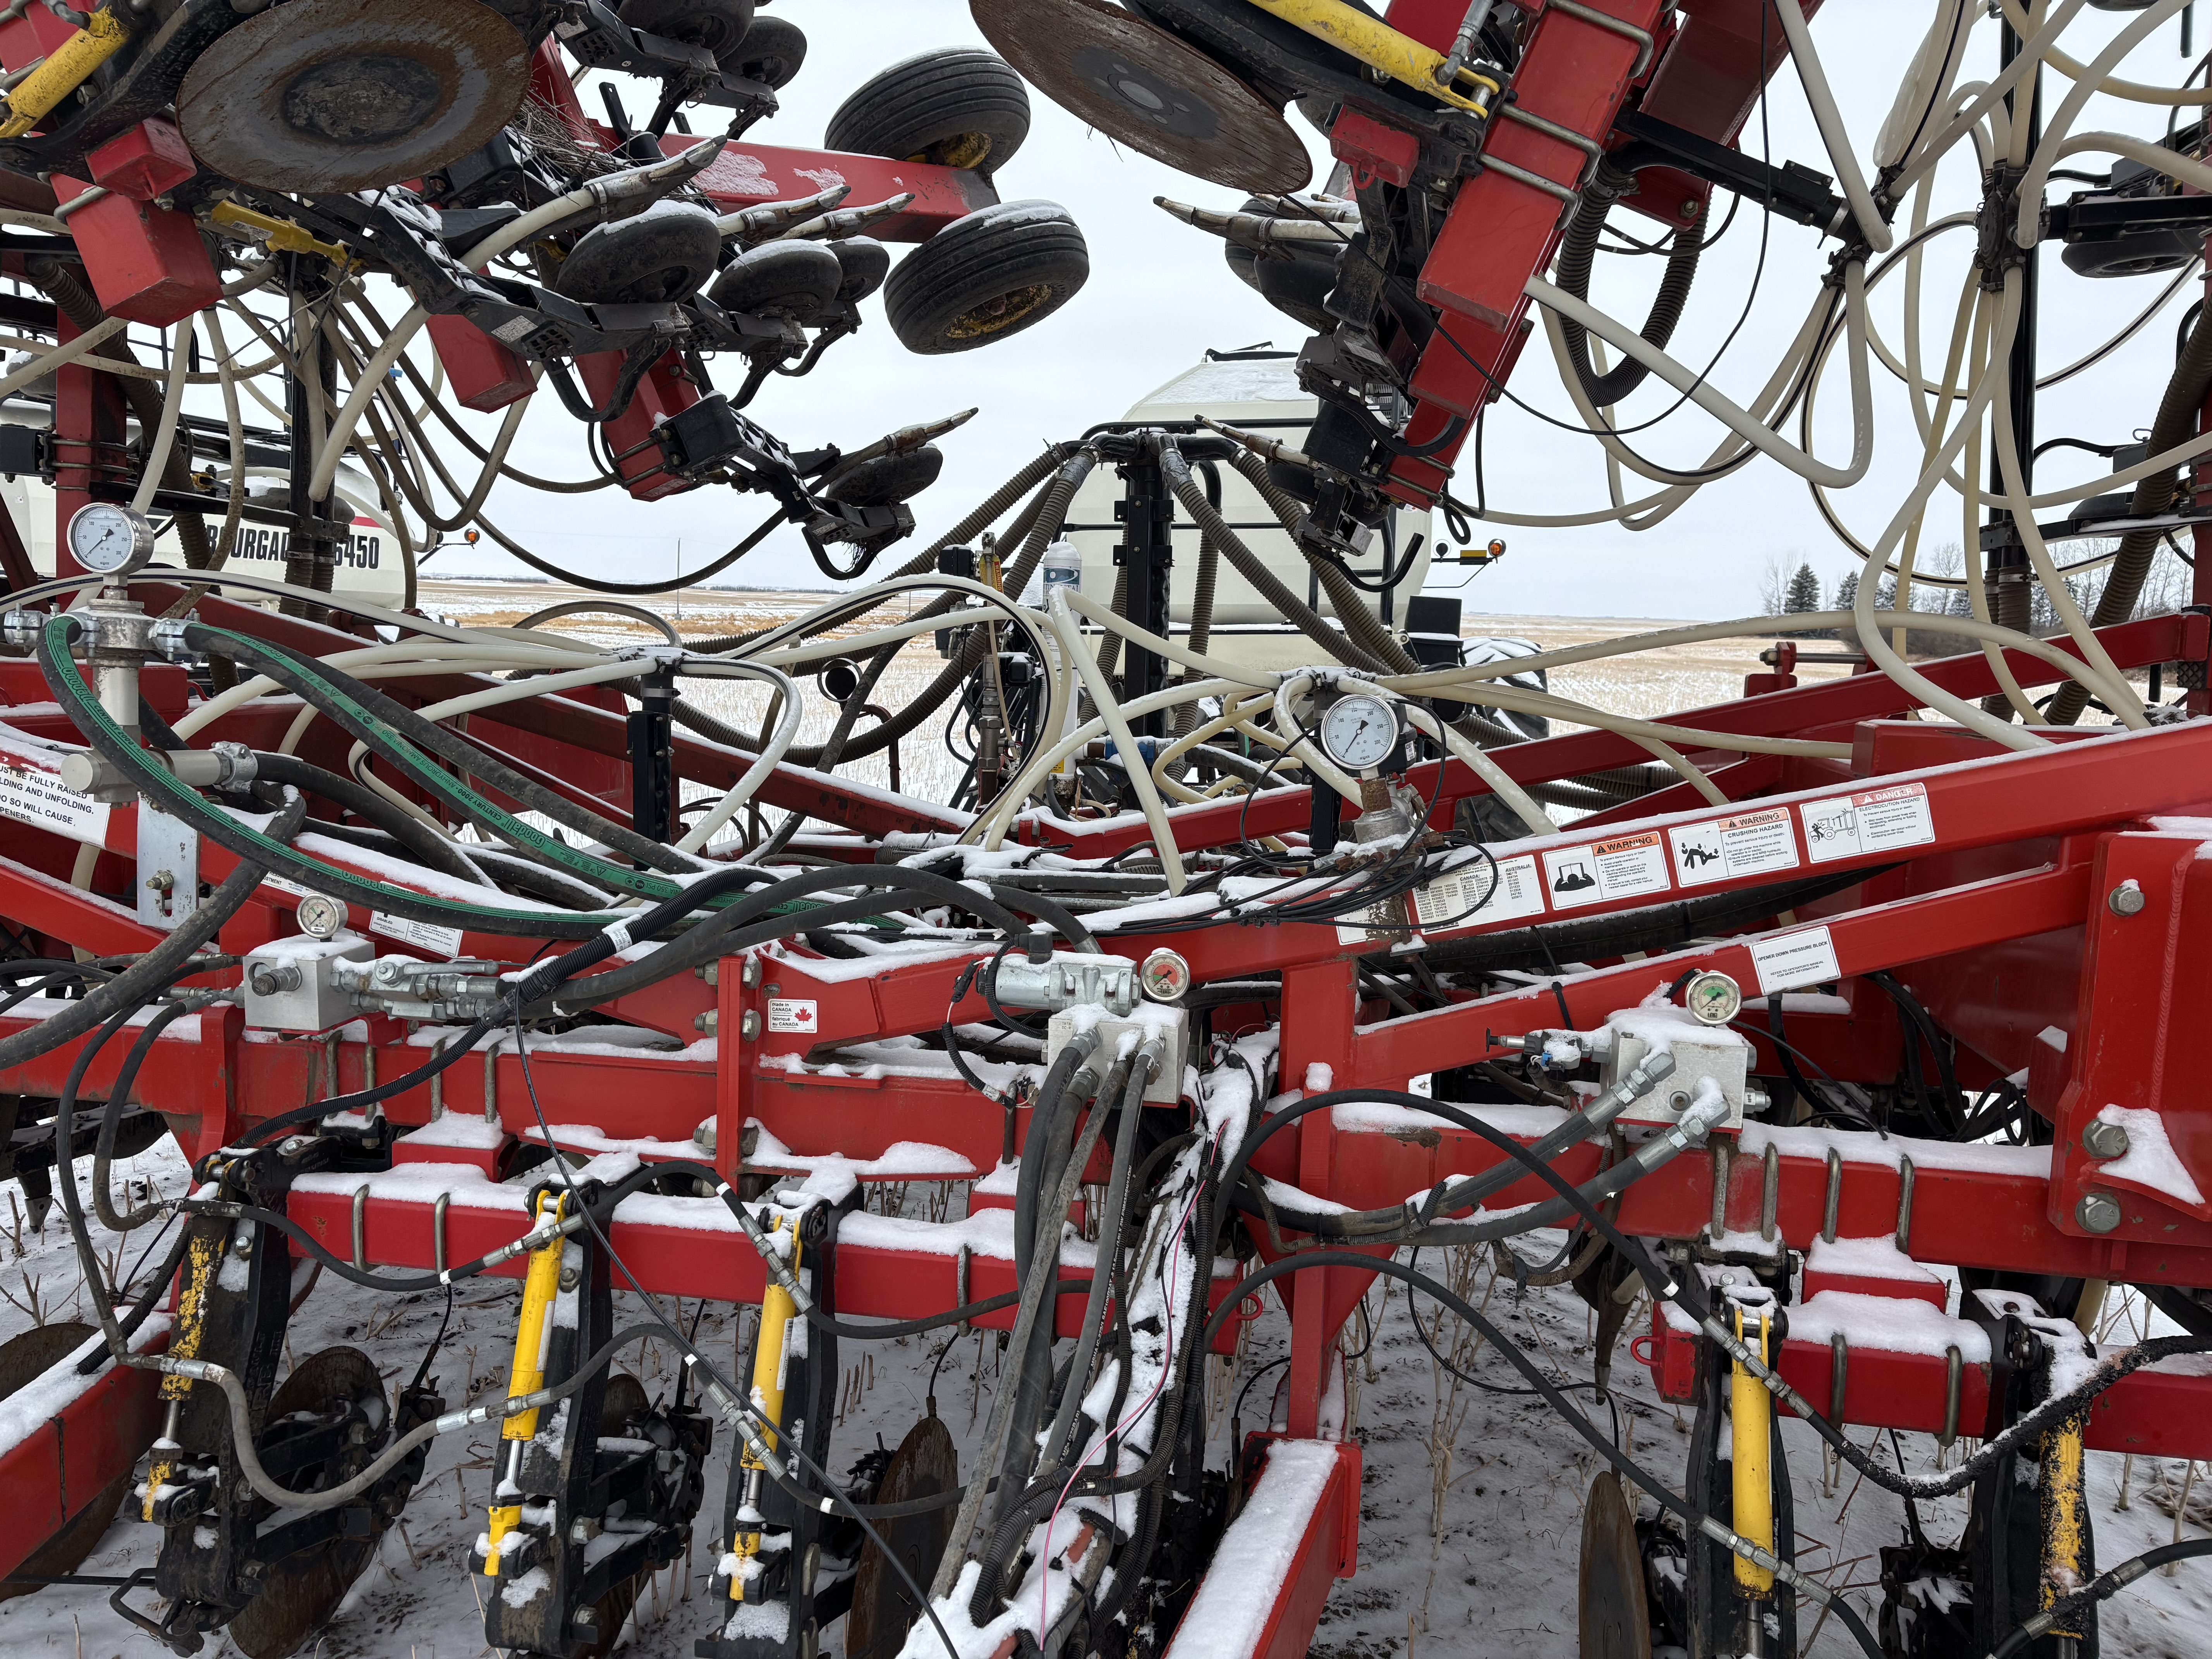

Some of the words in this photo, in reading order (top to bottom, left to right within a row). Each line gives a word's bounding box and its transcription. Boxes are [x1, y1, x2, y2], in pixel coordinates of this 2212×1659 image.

[392, 738, 421, 763] AMMONIA
[94, 705, 120, 731] CENTURY
[118, 730, 134, 745] 2000
[135, 747, 173, 781] ANHYDROUS
[172, 779, 204, 804] AMMONIA
[204, 801, 218, 811] 350
[217, 809, 228, 819] PSI
[420, 759, 455, 788] ANHYDROUS
[15, 770, 27, 780] BE
[29, 775, 55, 789] FULLY
[57, 783, 87, 799] RAISED
[25, 785, 42, 797] AND
[45, 792, 94, 814] UNFOLDING.
[457, 788, 472, 801] 2000
[1875, 788, 1913, 801] DANGER
[9, 797, 21, 807] SO
[23, 802, 43, 814] WILL
[45, 809, 73, 824] CAUSE
[472, 797, 502, 821] CENTURY
[1859, 801, 1899, 812] ELECTROCUTION
[1739, 812, 1779, 826] WARNING
[503, 819, 546, 848] Goodall
[1728, 828, 1758, 838] CRUSHING
[1759, 823, 1783, 832] HAZARD
[1607, 836, 1652, 851] WARNING
[1505, 863, 1532, 872] AUSTRALIA:
[657, 885, 670, 893] 350
[1757, 953, 1775, 962] OPENER
[1789, 944, 1812, 954] PRESSURE
